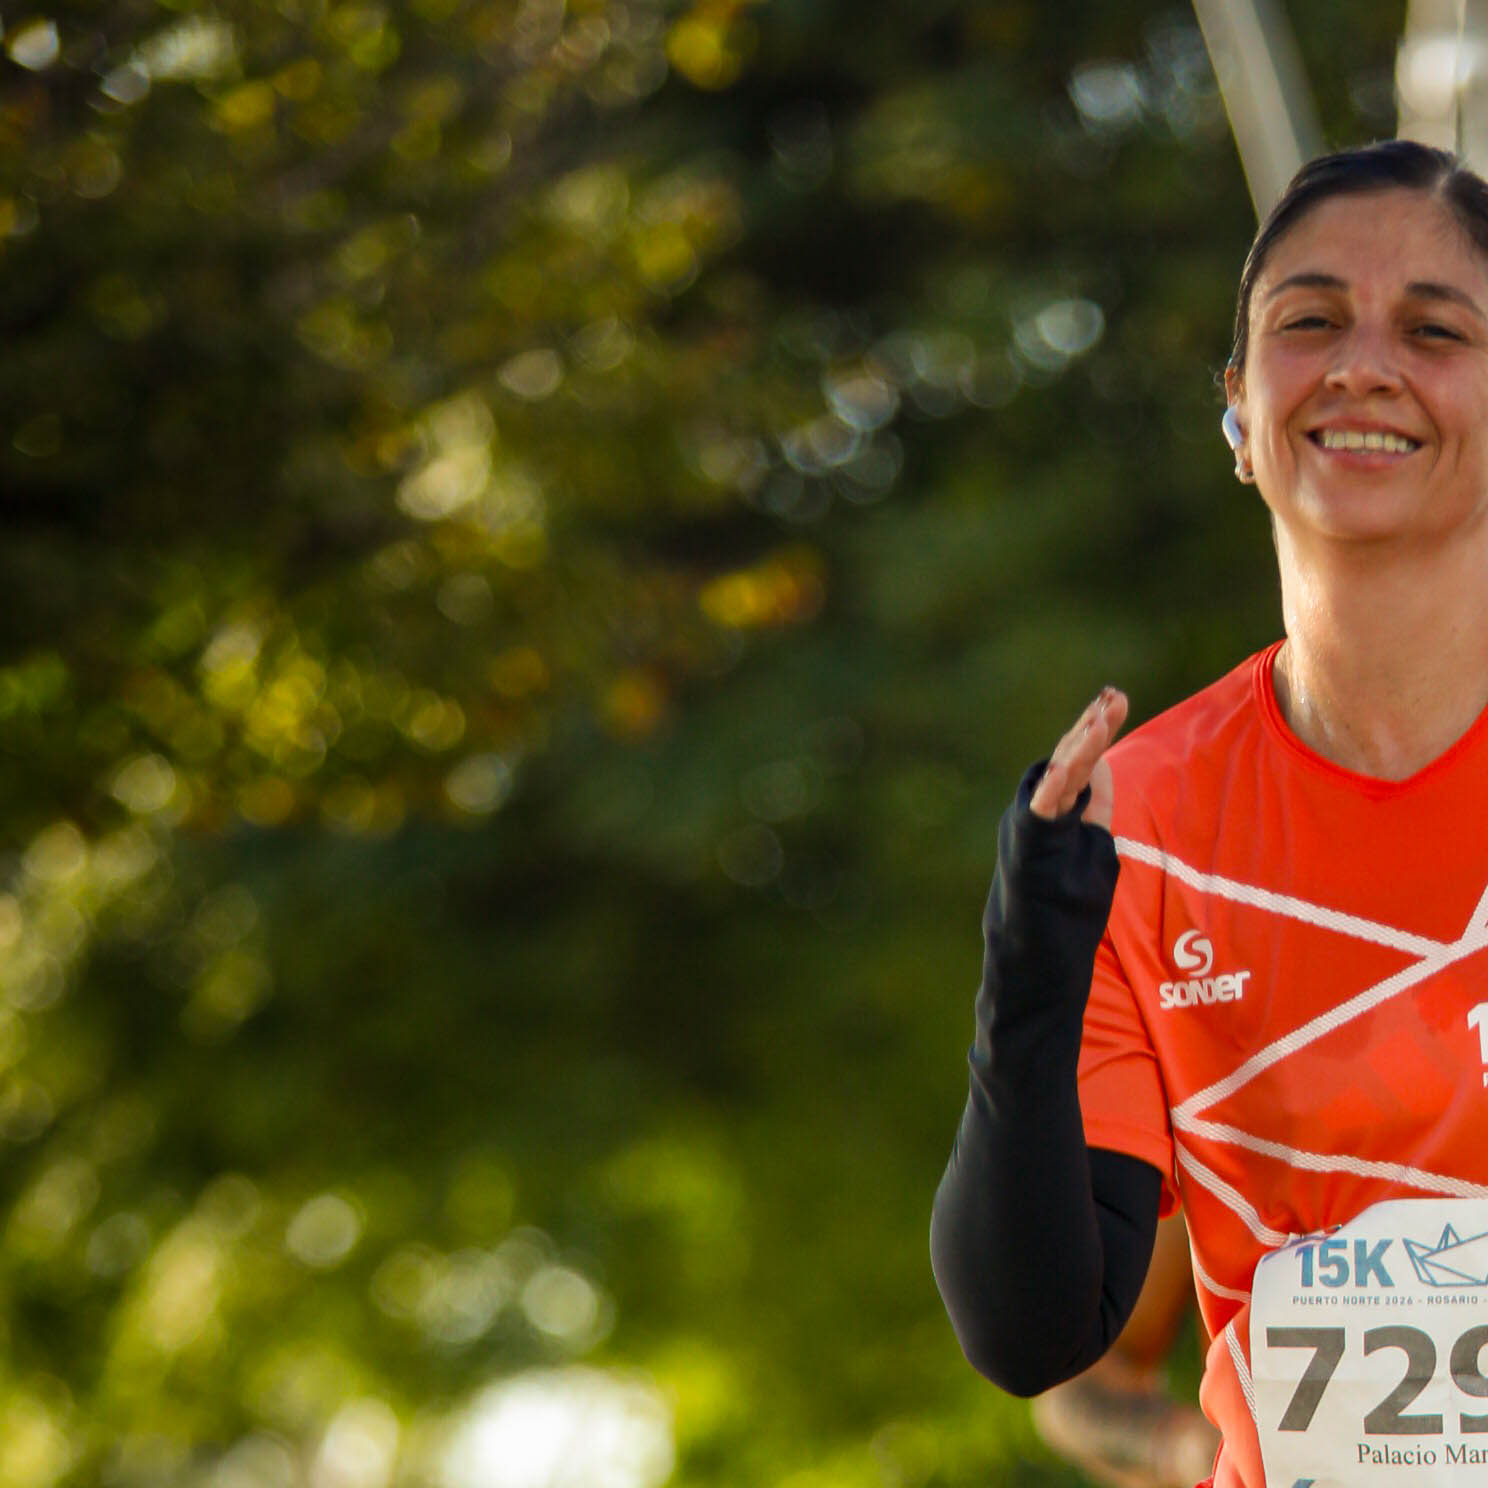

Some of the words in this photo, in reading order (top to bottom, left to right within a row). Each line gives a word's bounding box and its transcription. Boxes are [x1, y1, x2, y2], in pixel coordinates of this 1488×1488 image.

[1294, 1238, 1395, 1288] 15K
[1292, 1295, 1338, 1305] PUERTO
[1342, 1295, 1380, 1305] NORTE
[1385, 1296, 1414, 1305] 2026
[1427, 1295, 1479, 1305] ROSARIO
[1356, 1443, 1437, 1465] Palacio
